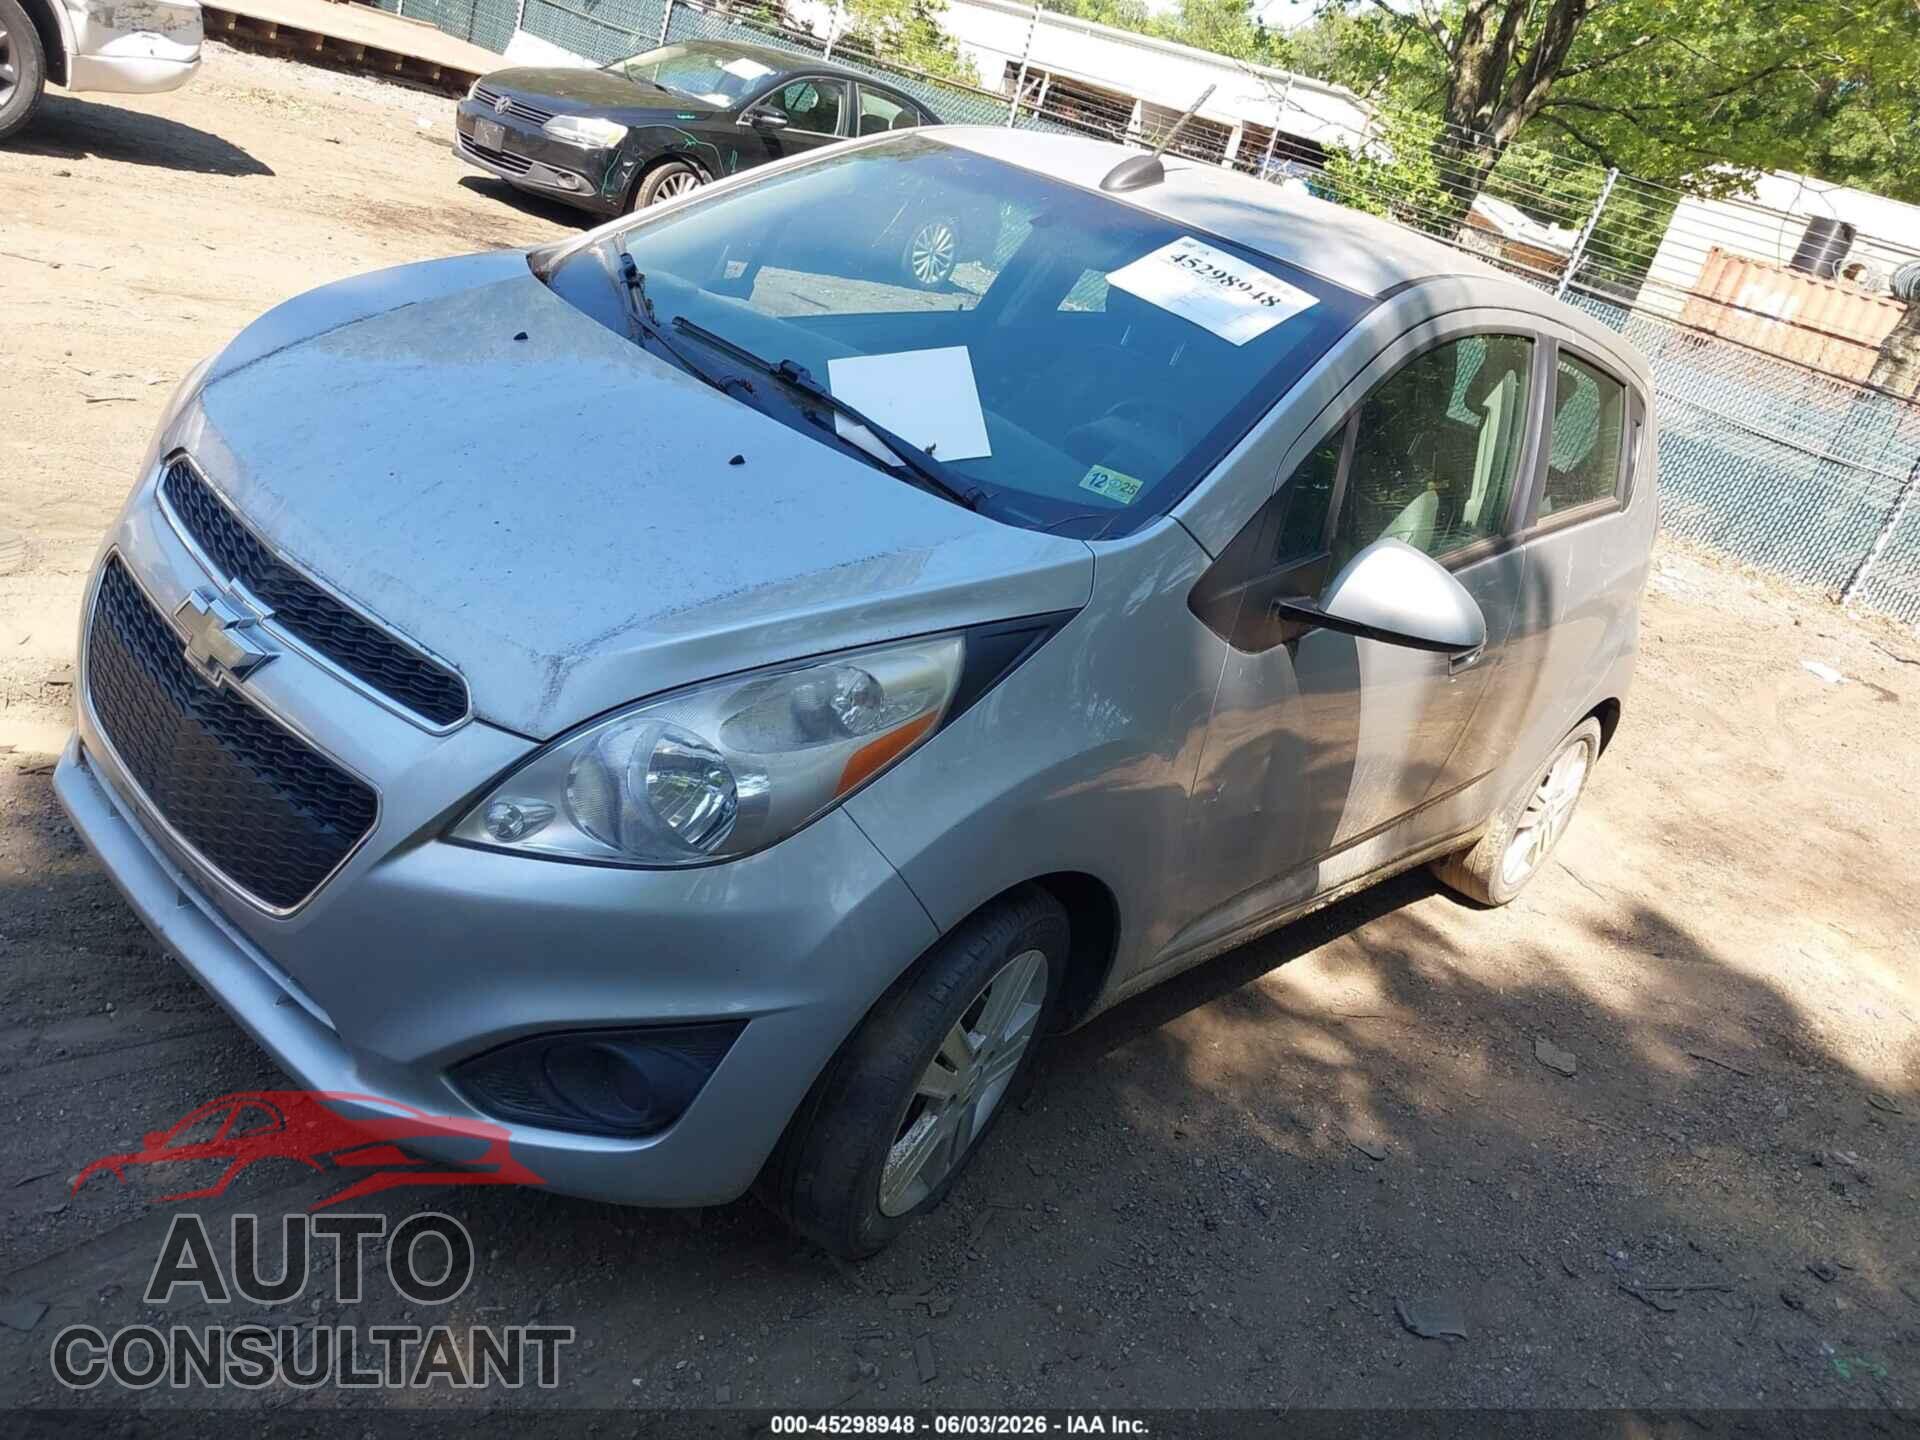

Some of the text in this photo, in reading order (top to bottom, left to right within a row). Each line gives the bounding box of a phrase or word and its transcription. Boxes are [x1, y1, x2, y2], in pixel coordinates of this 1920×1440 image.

[1170, 254, 1281, 308] 45298948
[1089, 472, 1138, 495] 12 25
